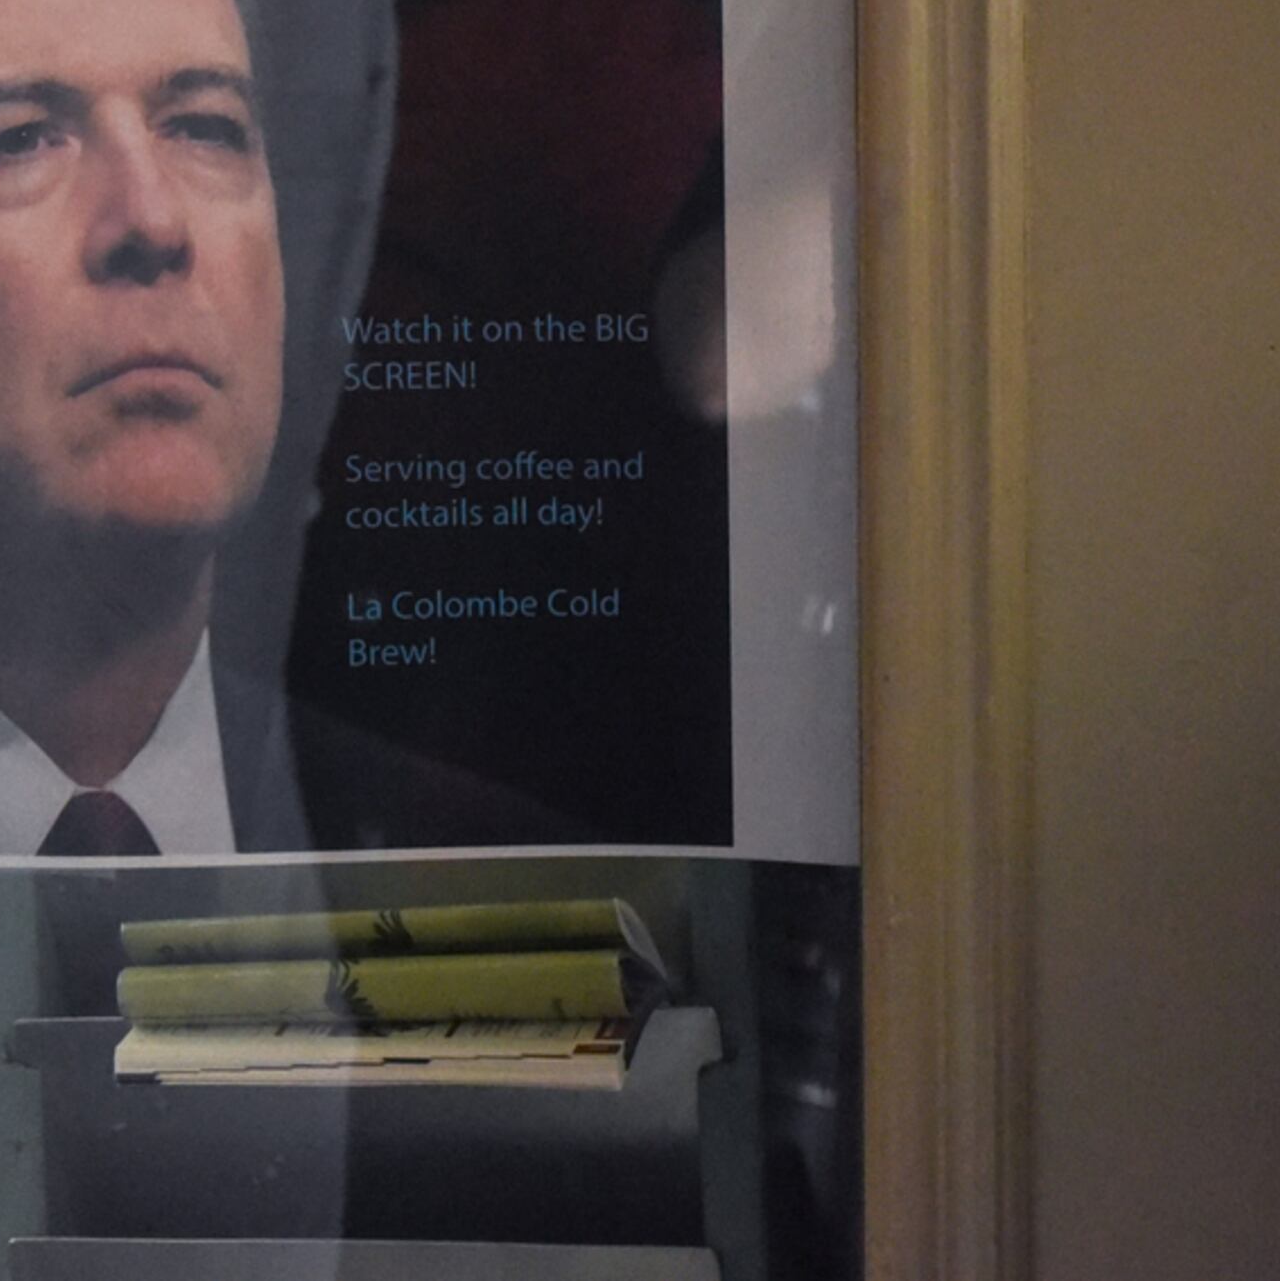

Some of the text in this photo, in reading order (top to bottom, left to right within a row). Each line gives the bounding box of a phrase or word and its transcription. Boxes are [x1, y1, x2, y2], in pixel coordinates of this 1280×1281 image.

[341, 313, 649, 344] Watch it on the BIG
[343, 360, 477, 391] SCREEN!
[345, 450, 644, 488] Serving coffee and
[346, 496, 604, 533] cocktails all day!
[346, 587, 621, 622] La Colombe Cold
[348, 636, 437, 668] Brew!
